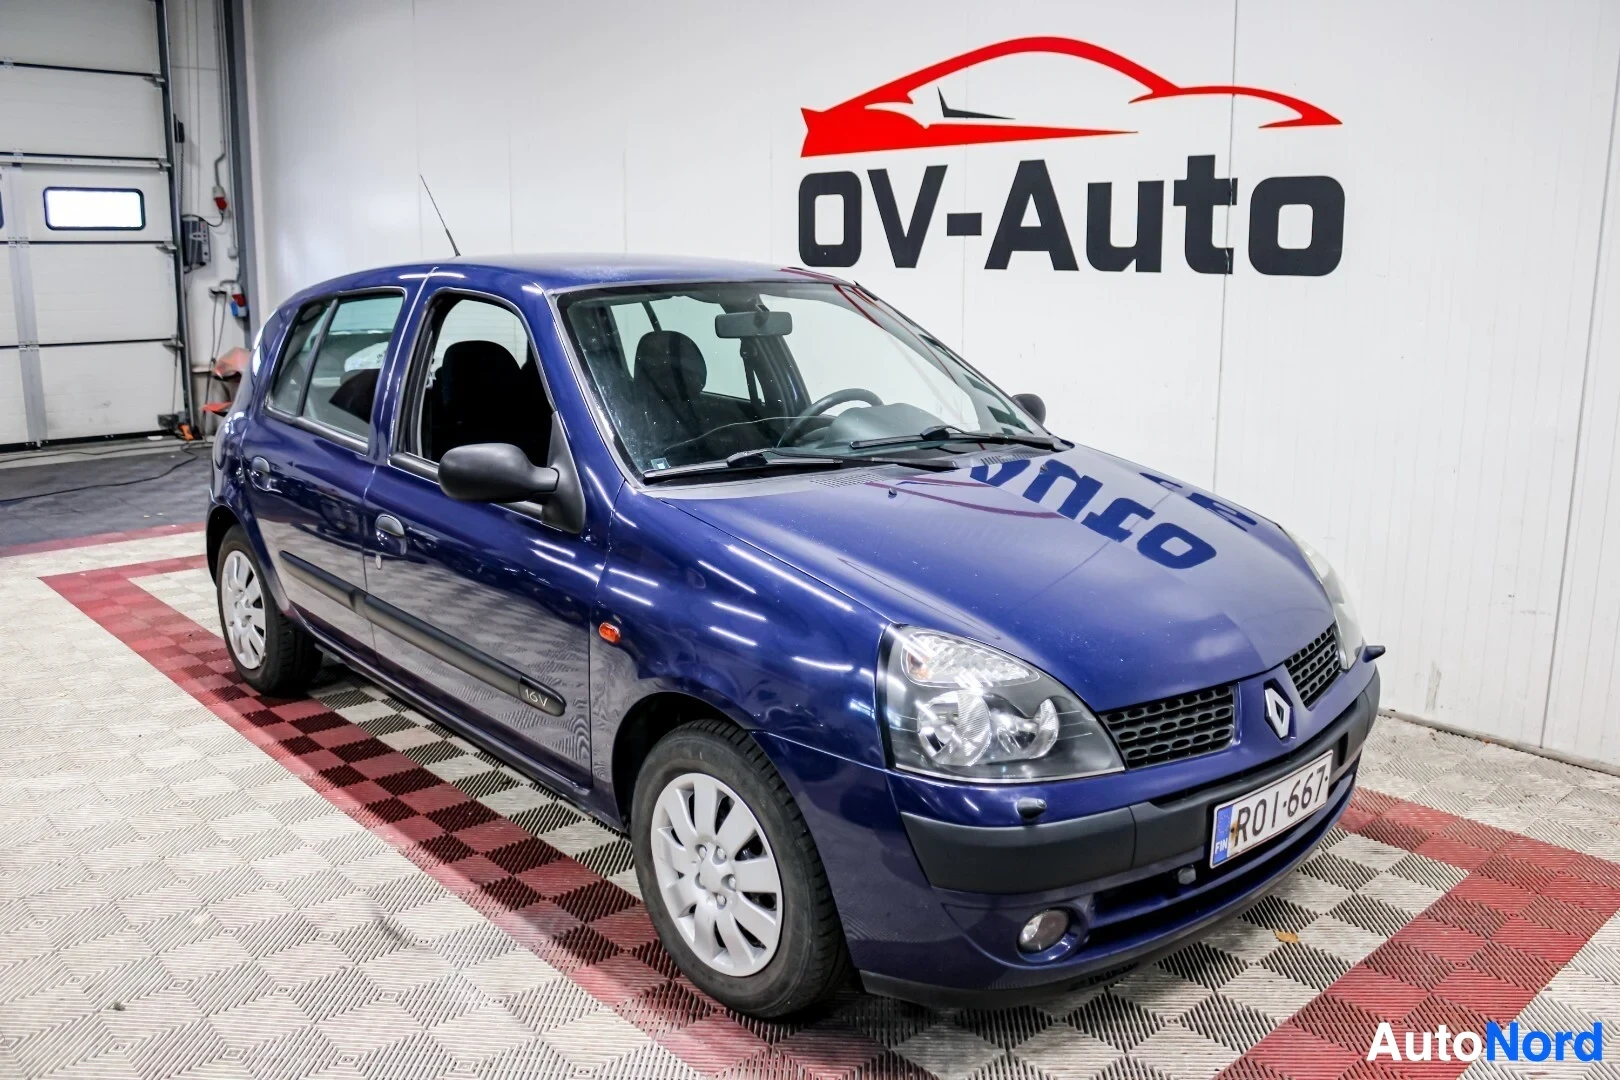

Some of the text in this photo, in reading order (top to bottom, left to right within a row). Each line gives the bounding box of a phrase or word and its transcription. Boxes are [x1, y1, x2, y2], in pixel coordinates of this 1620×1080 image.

[525, 688, 548, 707] 16V
[1233, 763, 1328, 848] ROI-667
[1215, 837, 1228, 855] FIN
